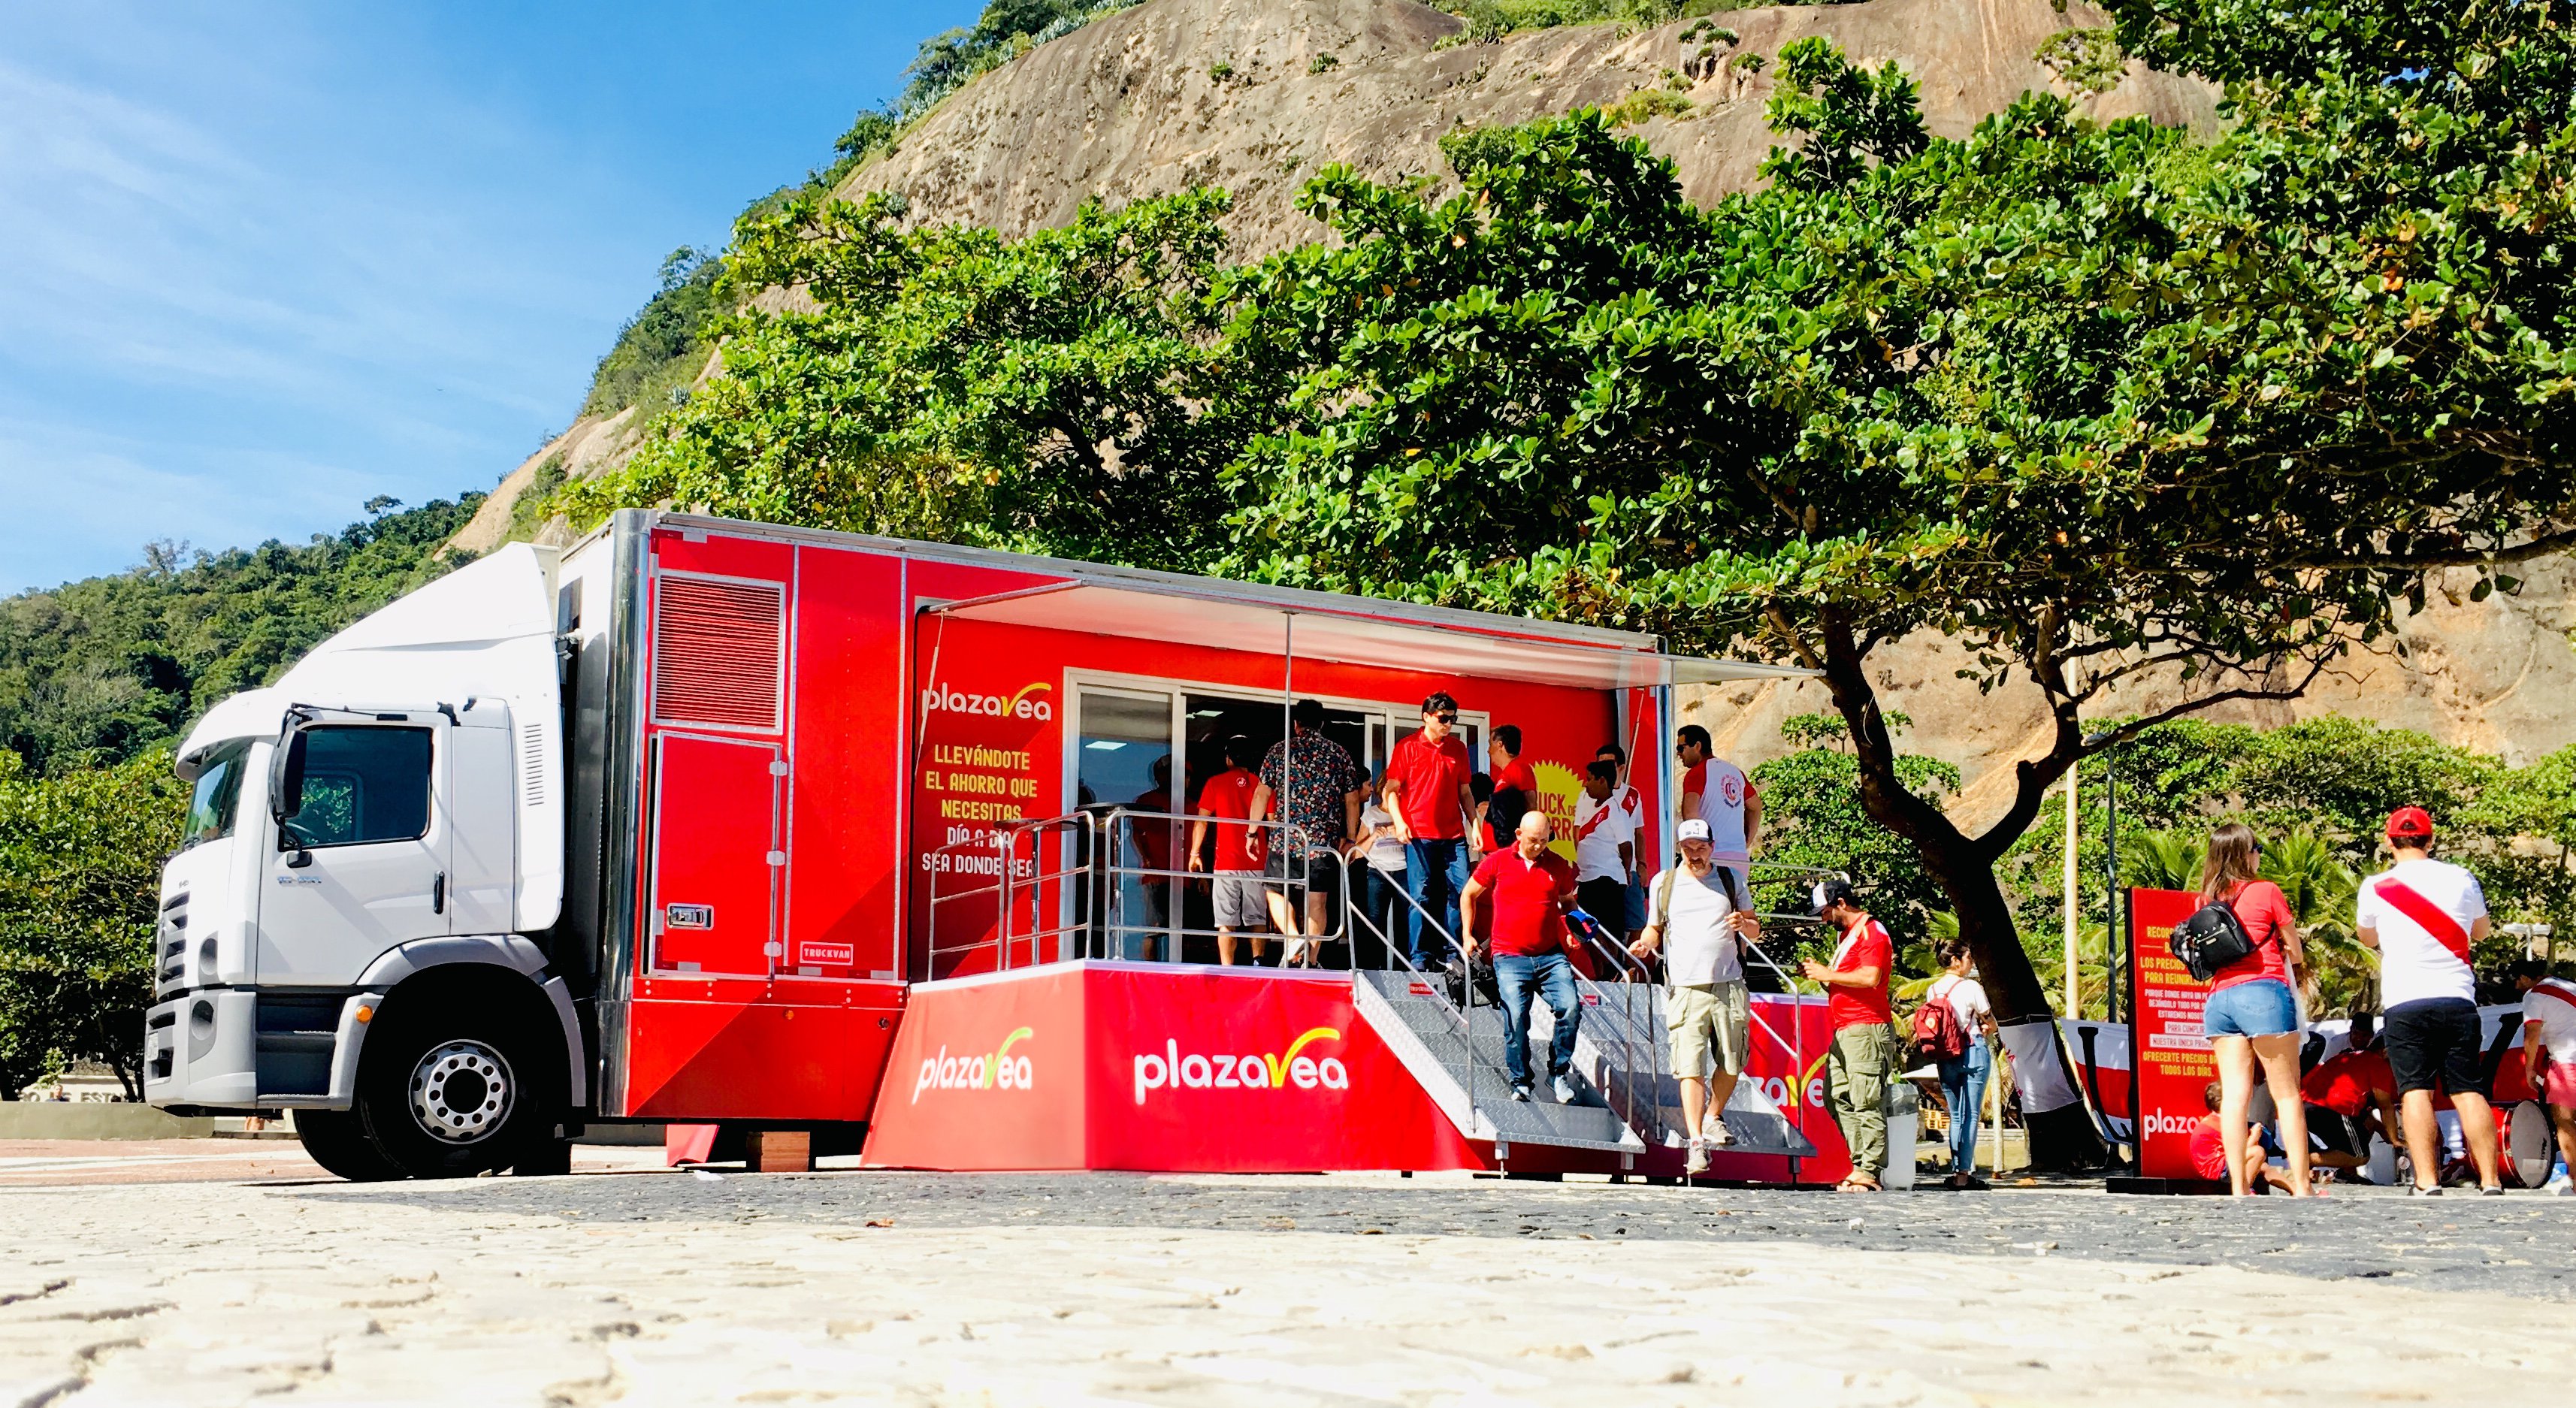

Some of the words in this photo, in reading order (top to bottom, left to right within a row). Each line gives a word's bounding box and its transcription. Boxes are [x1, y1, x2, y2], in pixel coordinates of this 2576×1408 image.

[922, 682, 1051, 721] plazavea
[934, 745, 1030, 770] LLEVÁNDOTE
[926, 771, 944, 790] EL
[950, 773, 1005, 793] AHORRO
[1011, 779, 1038, 798] QUE
[942, 799, 1022, 820] NECESITAS
[1538, 791, 1568, 816] UCK
[947, 823, 969, 847] DÍA
[975, 829, 984, 847] A
[922, 853, 950, 872] SEA
[955, 854, 1001, 875] DONDE
[803, 947, 851, 959] TRUCKVAN
[2140, 956, 2154, 968] LOS
[2156, 957, 2185, 971] PRECIOS
[2145, 971, 2163, 983] PARA
[2152, 1038, 2177, 1047] NUESTRA
[912, 1027, 1033, 1104] plazavea
[1135, 1027, 1349, 1105] plazavea
[2143, 1051, 2180, 1062] OFRECERTE
[2181, 1053, 2208, 1063] PRECIOS
[2160, 1065, 2181, 1075] TODOS
[2183, 1065, 2196, 1076] LOS
[2144, 1107, 2203, 1141] plaza
